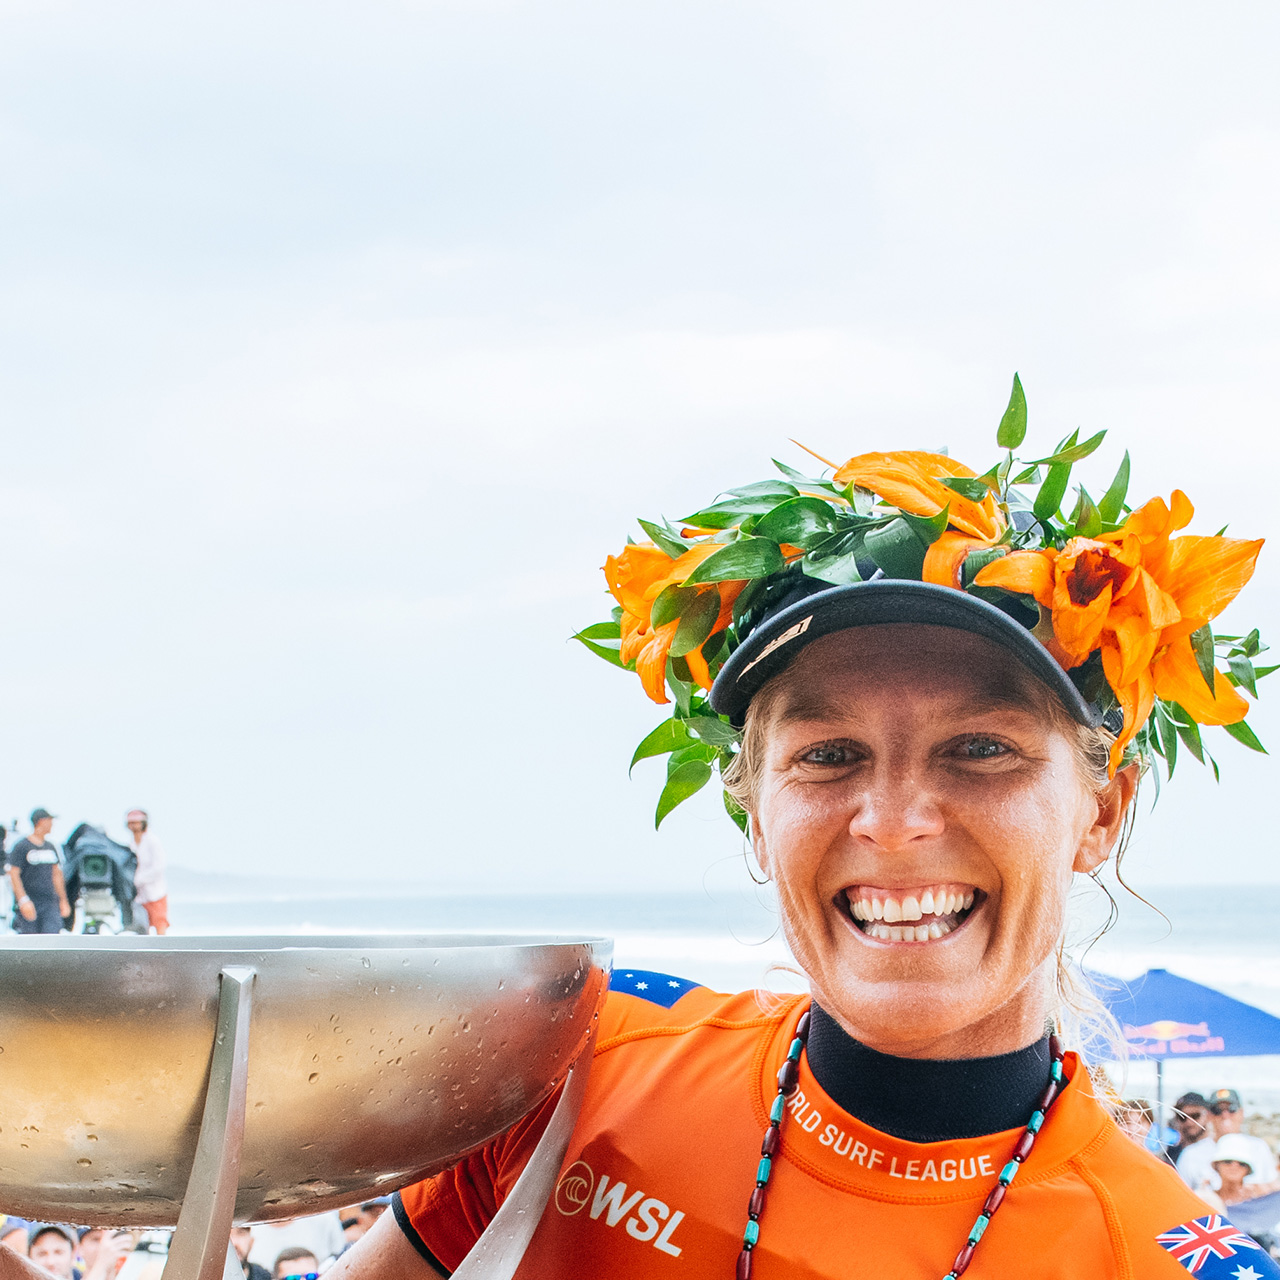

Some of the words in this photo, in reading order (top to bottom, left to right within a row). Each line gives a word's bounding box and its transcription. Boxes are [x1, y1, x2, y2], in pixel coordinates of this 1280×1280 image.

[818, 1124, 885, 1170] SURF
[889, 1154, 996, 1182] LEAGUE
[589, 1174, 686, 1258] WSL
